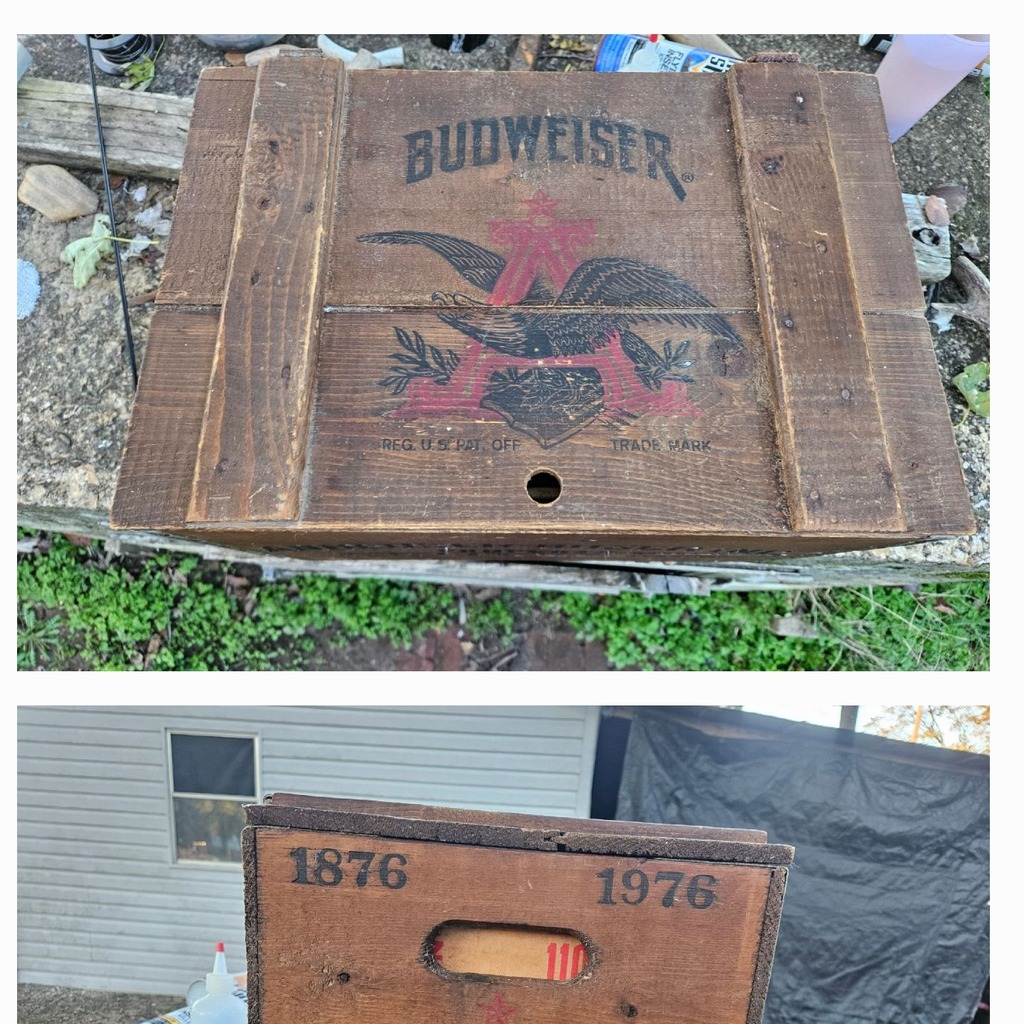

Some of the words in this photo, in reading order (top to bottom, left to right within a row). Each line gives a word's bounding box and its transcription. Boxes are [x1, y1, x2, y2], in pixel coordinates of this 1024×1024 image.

[611, 438, 660, 452] TRADE
[668, 438, 711, 453] MARK
[289, 846, 408, 890] 1876
[596, 867, 720, 910] 1976
[547, 942, 586, 981] 110
